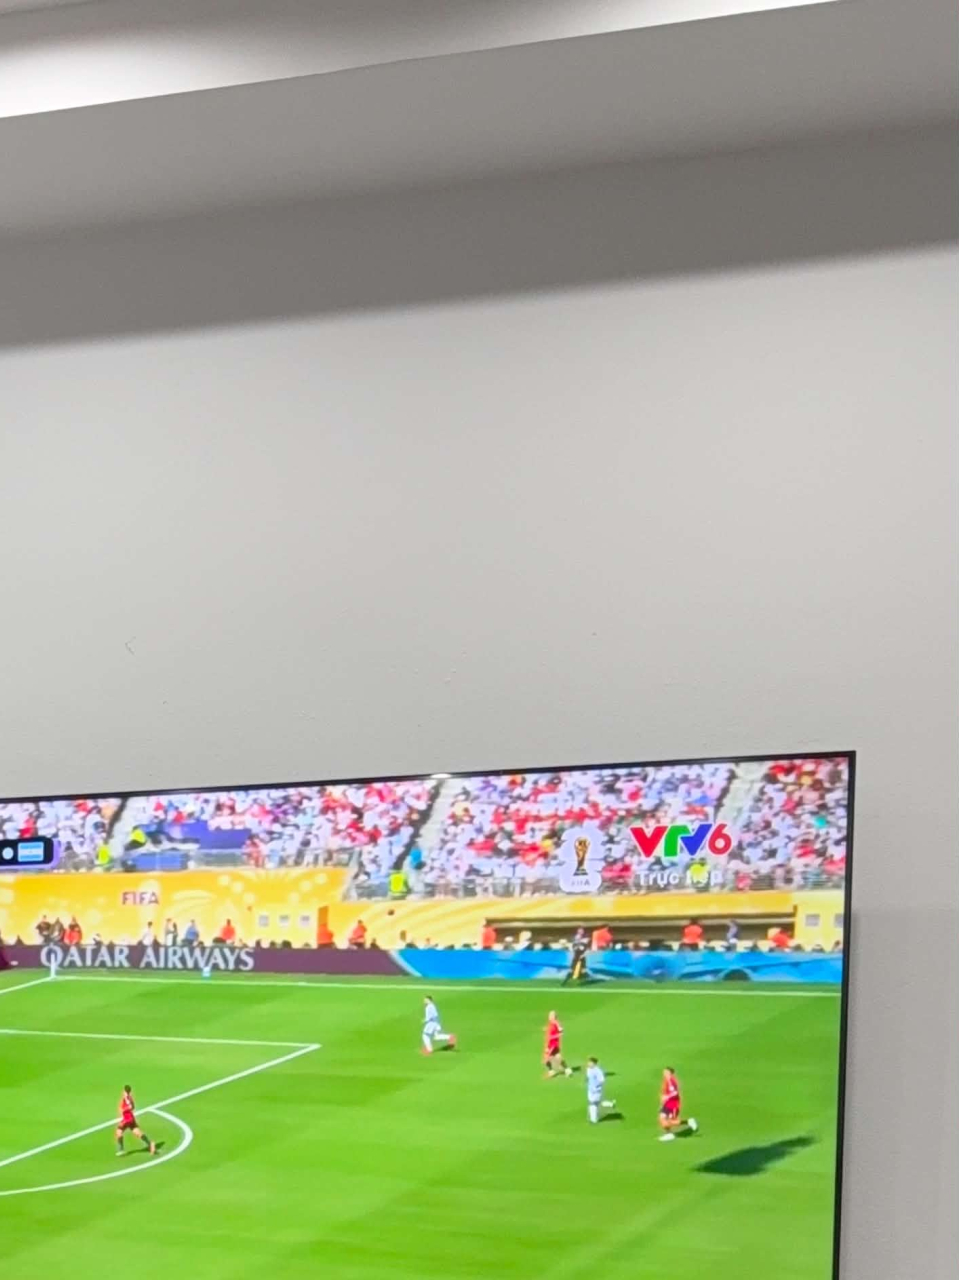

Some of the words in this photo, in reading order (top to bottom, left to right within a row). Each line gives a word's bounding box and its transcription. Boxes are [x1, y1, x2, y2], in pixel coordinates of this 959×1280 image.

[629, 823, 732, 858] VTV6
[685, 867, 724, 888] tp
[121, 891, 160, 905] FIFA
[40, 943, 130, 970] QATAR
[140, 945, 255, 971] AIRWAYS
